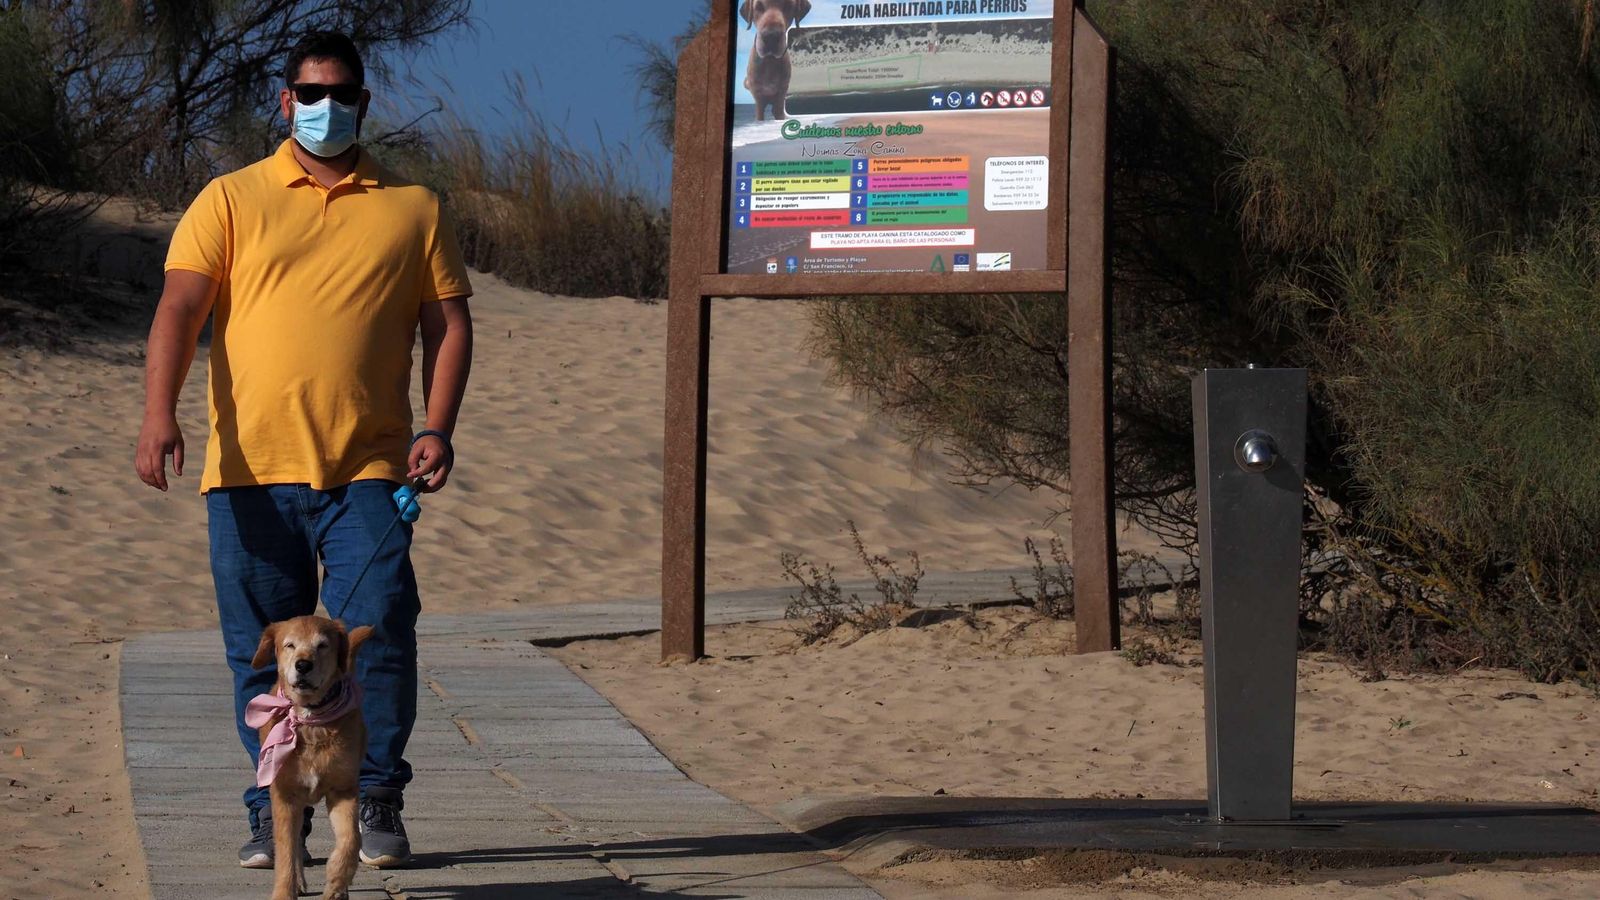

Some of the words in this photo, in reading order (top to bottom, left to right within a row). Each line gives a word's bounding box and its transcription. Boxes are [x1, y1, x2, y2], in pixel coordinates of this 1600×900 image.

[840, 4, 871, 19] ZONA
[874, 2, 942, 18] HABILITADA
[946, 0, 977, 16] PARA
[980, 0, 1027, 13] PERROS
[781, 119, 842, 140] Cuidemos
[845, 122, 882, 137] nuestro
[886, 122, 923, 136] entorno
[802, 144, 839, 158] Normas
[844, 142, 867, 156] Zona
[870, 141, 905, 155] Canina
[741, 165, 746, 173] 1
[857, 196, 862, 204] 7
